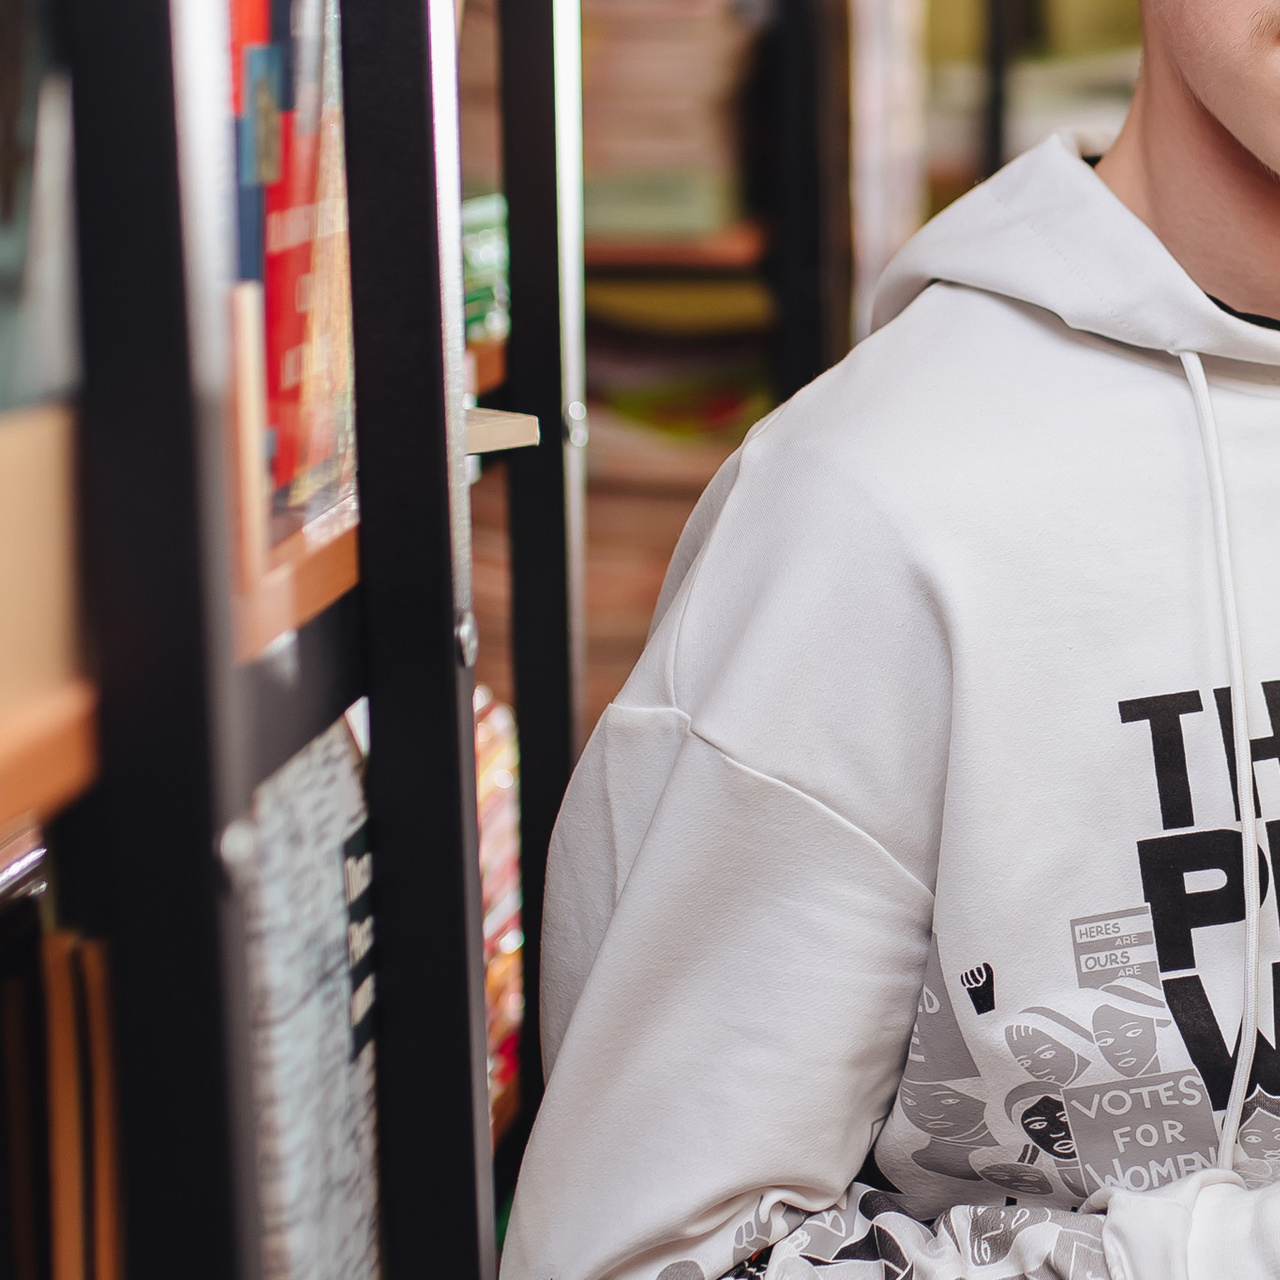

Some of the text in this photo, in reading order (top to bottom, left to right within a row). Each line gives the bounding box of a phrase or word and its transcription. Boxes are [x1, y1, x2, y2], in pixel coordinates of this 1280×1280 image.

[1078, 922, 1121, 940] HERES
[1114, 933, 1139, 947] ARE
[1084, 950, 1131, 971] OURS
[1116, 964, 1142, 978] ARE
[1070, 1074, 1203, 1119] VOTES
[1112, 1120, 1186, 1153] FOR
